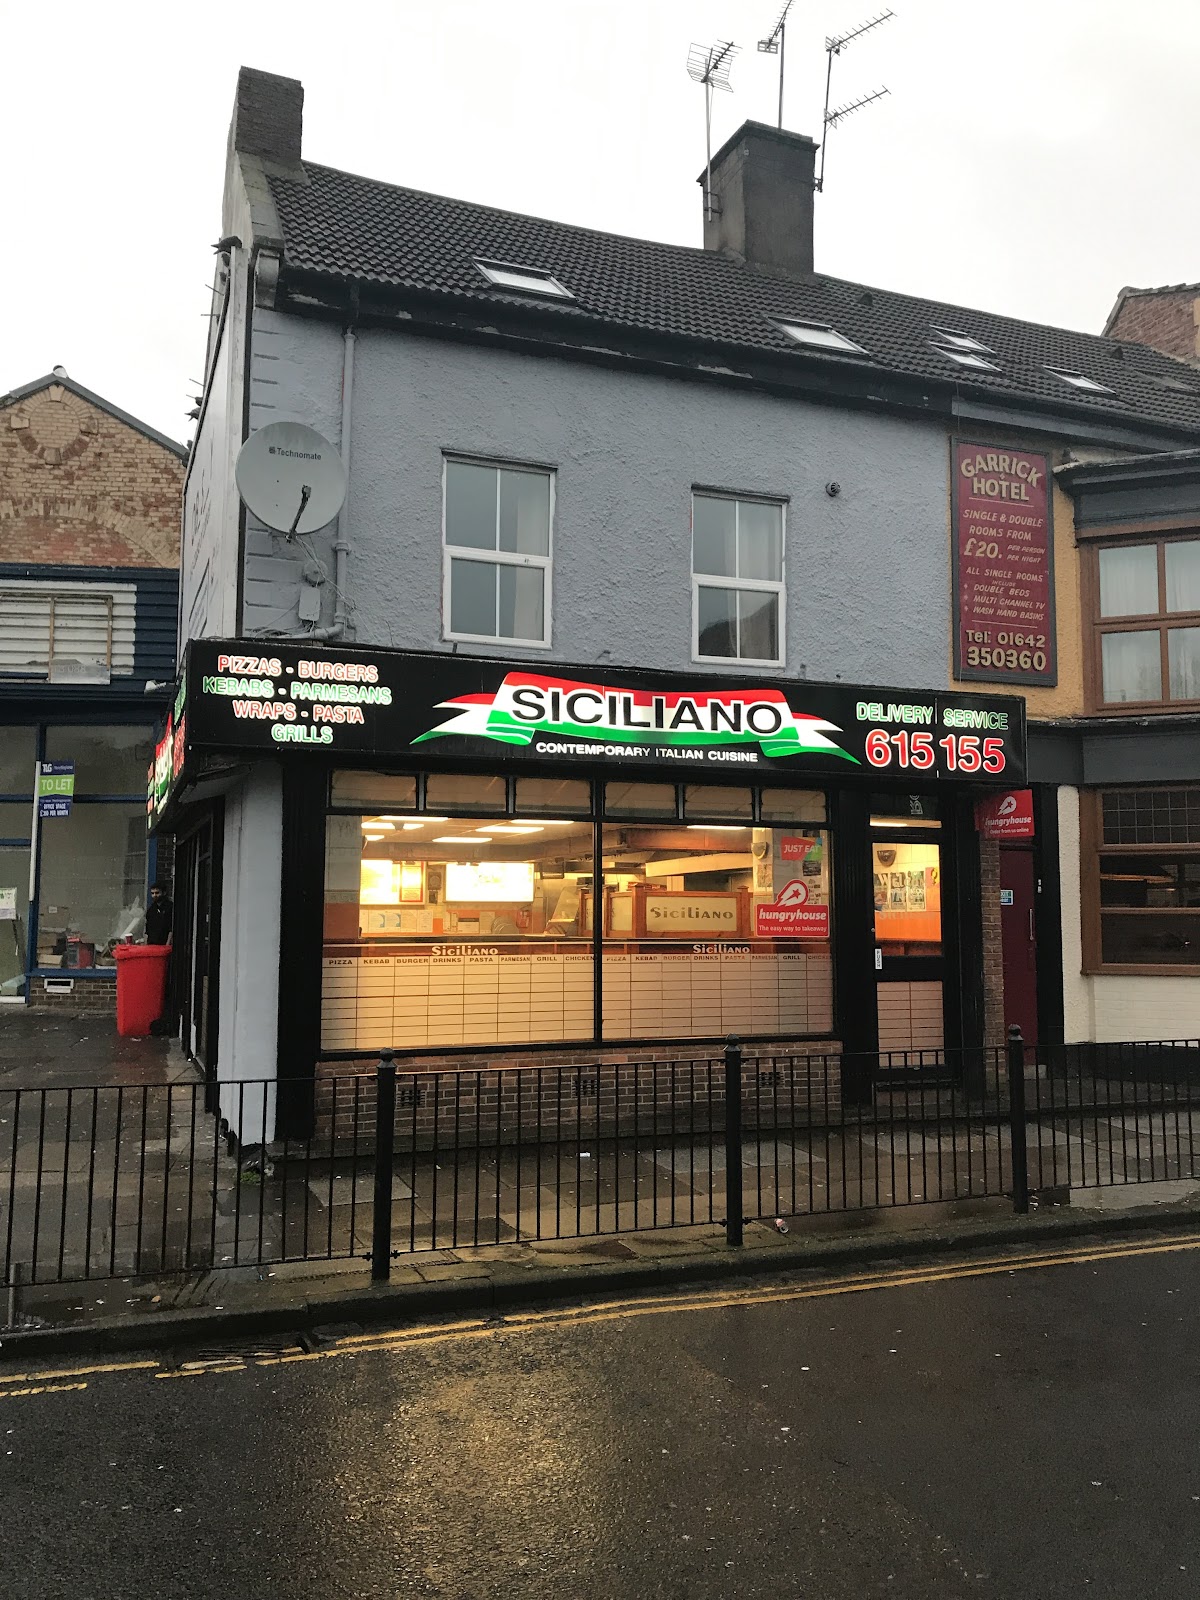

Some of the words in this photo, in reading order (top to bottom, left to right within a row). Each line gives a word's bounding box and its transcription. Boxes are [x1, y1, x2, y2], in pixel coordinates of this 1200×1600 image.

[277, 447, 321, 460] Technomate
[961, 454, 1043, 488] GARRICK
[973, 477, 1029, 500] HOTEL
[963, 509, 997, 521] SINGLE
[1000, 513, 1007, 523] &
[1008, 514, 1043, 527] DOUBLE
[969, 525, 1003, 537] ROOMS
[1006, 530, 1032, 541] FROM
[1007, 544, 1020, 552] PER
[1022, 546, 1045, 555] PERSON
[1022, 556, 1041, 564] NIGHT
[966, 566, 980, 575] ALL
[984, 568, 1012, 579] SINGLE
[1016, 572, 1044, 583] ROOMS
[974, 583, 1005, 594] DOUBLE
[1009, 588, 1031, 598] BEDS
[973, 595, 997, 604] MULTI
[1000, 598, 1033, 609] CHANNEL
[1035, 602, 1046, 610] TV
[973, 606, 994, 615] WASH
[997, 608, 1018, 617] HAND
[1020, 611, 1045, 620] BASINS
[997, 632, 1046, 648] 01642
[967, 646, 1047, 671] 350360
[218, 655, 281, 676] PIZZAS
[298, 661, 379, 682] BURGERS
[203, 676, 274, 698] KEBABS
[290, 682, 393, 705] PARMESANS
[232, 700, 296, 720] WRAPS
[313, 704, 365, 724] PASTA
[511, 687, 784, 735] SICILIANO
[856, 702, 933, 724] DELIVERY
[943, 708, 1009, 730] SERVICE
[271, 723, 334, 744] GRILLS
[536, 742, 650, 757] CONTEMPORARY
[656, 748, 704, 760] ITALIAN
[708, 750, 758, 762] CUISINE
[866, 728, 935, 769] 615
[939, 734, 1006, 774] 155
[41, 779, 54, 791] TO
[55, 778, 72, 790] LET
[985, 815, 1032, 826] hungryhouse
[783, 844, 803, 853] JUST
[804, 845, 820, 853] EAT
[759, 908, 827, 922] hungryhouse
